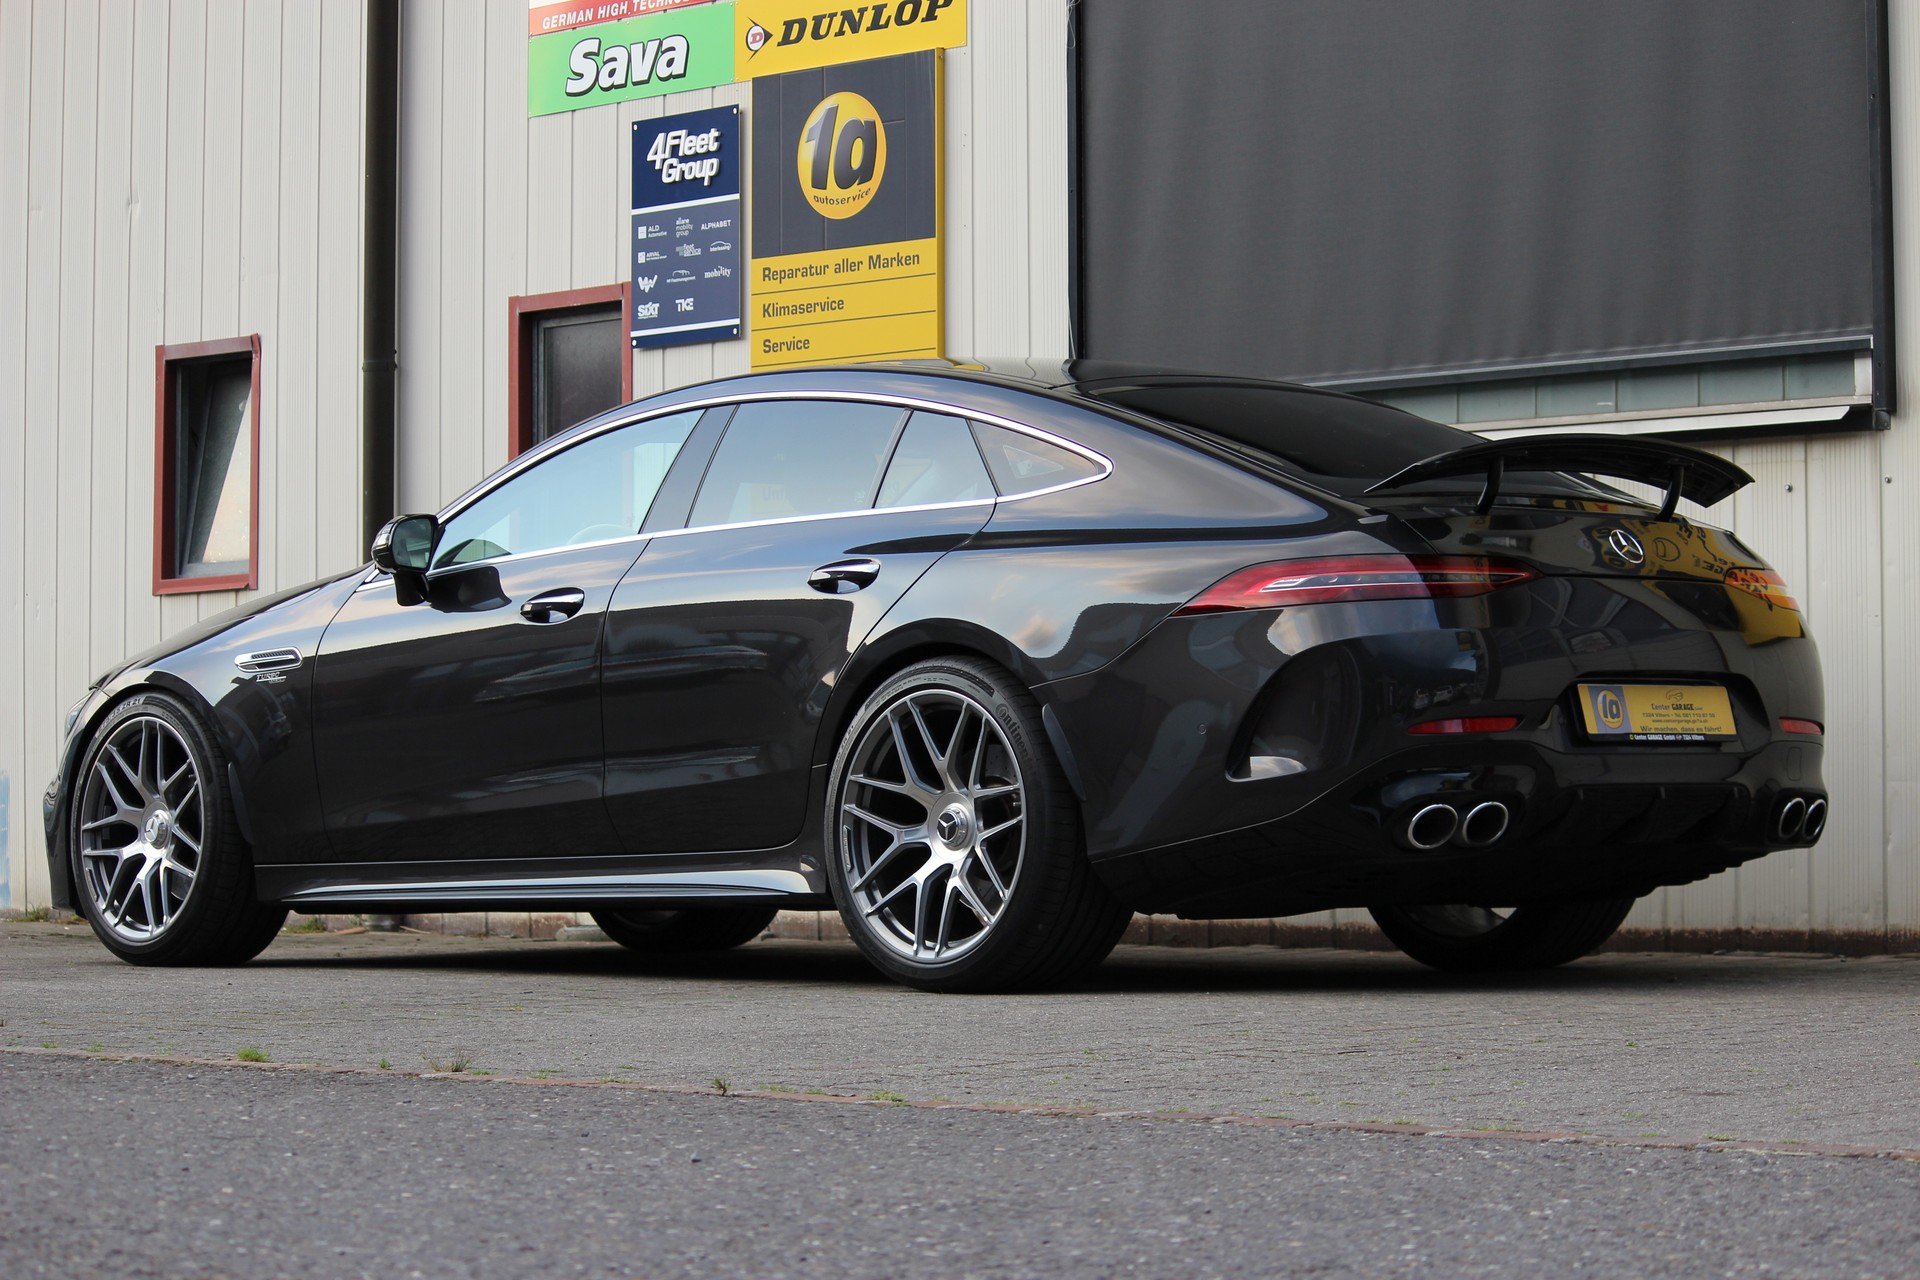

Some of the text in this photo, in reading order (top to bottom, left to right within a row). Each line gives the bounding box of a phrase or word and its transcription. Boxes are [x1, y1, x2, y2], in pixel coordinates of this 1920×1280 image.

[542, 9, 593, 30] GERMAN
[597, 3, 628, 20] HIGH
[776, 0, 954, 47] DUNLOP
[565, 34, 690, 97] Sava
[646, 127, 721, 170] 4Fleet
[805, 103, 878, 191] 1a
[661, 157, 720, 187] Group
[813, 188, 871, 206] autoservice
[700, 219, 732, 231] ALPHABET
[762, 252, 920, 284] Reparatur aller Marken
[762, 297, 845, 318] Klimaservice
[762, 336, 810, 354] Service
